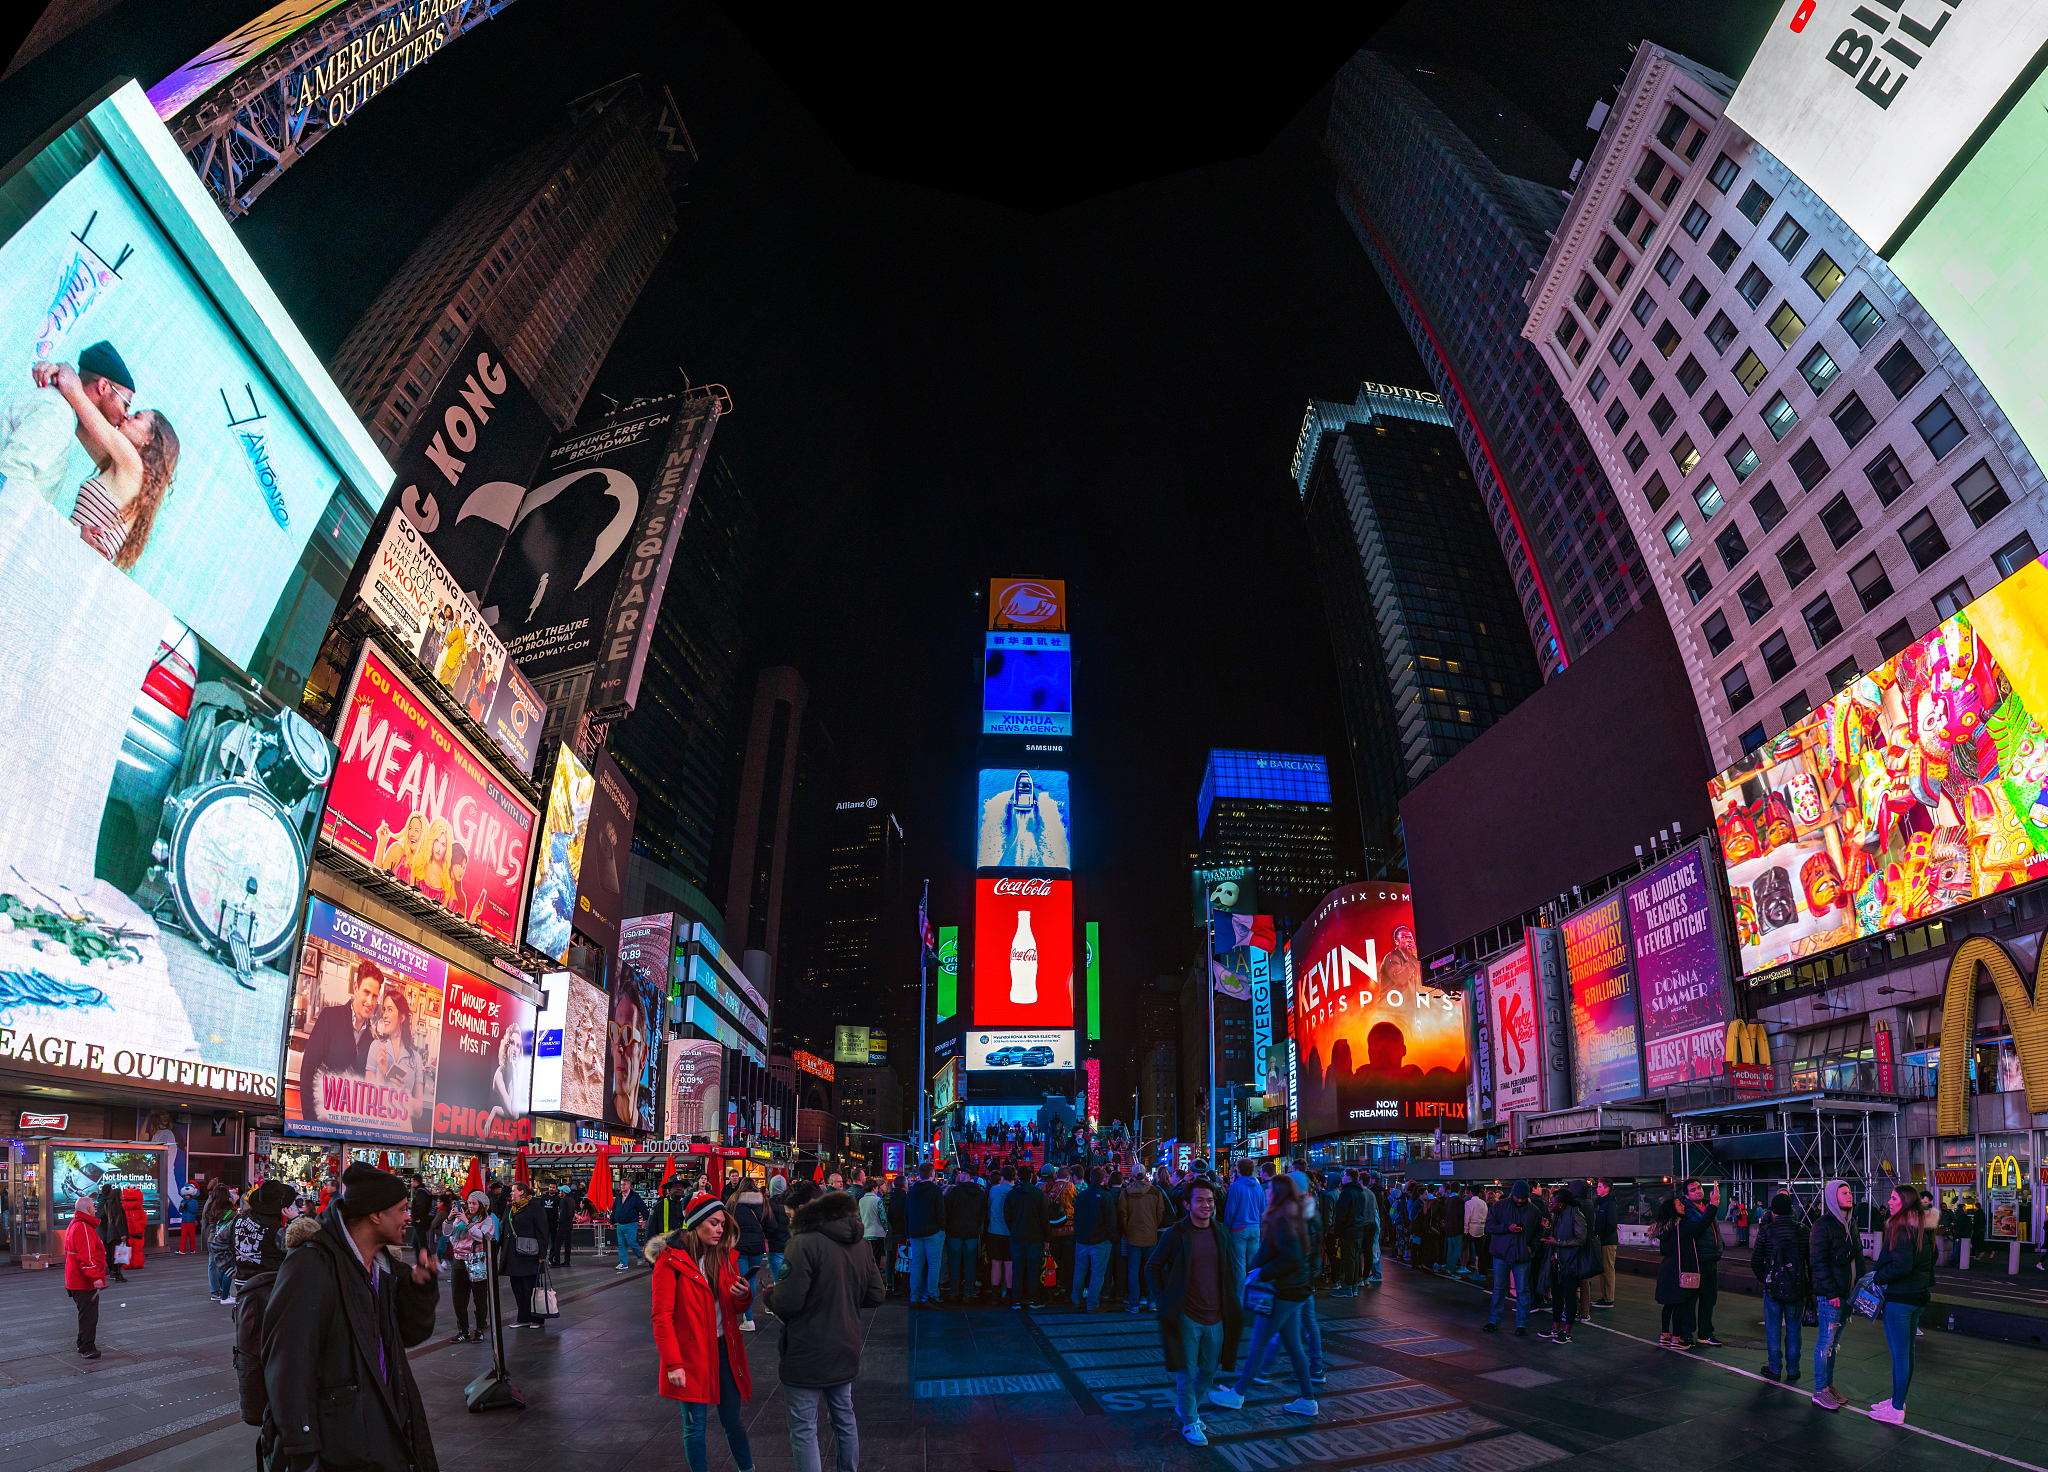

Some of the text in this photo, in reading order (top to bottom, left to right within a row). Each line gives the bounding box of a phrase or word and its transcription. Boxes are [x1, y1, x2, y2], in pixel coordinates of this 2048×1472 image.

[297, 6, 415, 114] AMERICAN
[329, 22, 445, 127] OUTFITTERS
[425, 352, 506, 487] KONG
[550, 415, 670, 459] BREAKING FREE ON
[570, 433, 640, 461] BROADWAY
[608, 417, 704, 662] TIMES SQUARE
[388, 541, 410, 568] THAT
[409, 566, 435, 603] GOES
[397, 536, 412, 558] THE
[413, 554, 436, 586] PLAY
[383, 550, 430, 617] WRONG
[398, 518, 505, 660] SO WRONG IT'S RIGHT
[545, 617, 590, 638] THEATRE
[525, 632, 576, 652] BROADWAY
[994, 636, 1062, 647] 新华通讯社
[601, 678, 621, 690] NYC
[508, 676, 539, 722] Avenue
[511, 700, 529, 739] Q
[990, 724, 1065, 733] NEWS AGENCY
[1002, 715, 1053, 726] XINHUA
[363, 661, 529, 831] YOU KNOW YOU WANNA SIT WITH US
[1025, 744, 1063, 752] SAMSUNG
[1270, 759, 1321, 771] BARCLAYS
[343, 704, 524, 886] MEAN GIRLS
[836, 801, 865, 811] Allianz
[994, 877, 1054, 897] Coca-Cola
[1202, 869, 1245, 880] PHANTOM
[1651, 862, 1698, 905] AUDIENCE
[1314, 919, 1318, 928] A
[1319, 892, 1367, 921] NETFLIX
[1577, 900, 1620, 939] INSPIRED
[1646, 893, 1688, 930] REACHES
[333, 917, 429, 972] JOEY McINTYRE
[351, 941, 377, 958] THROUGH
[377, 953, 392, 966] APRIL
[621, 949, 641, 961] 0.89
[1566, 921, 1622, 969] BROADWAY
[1637, 938, 1644, 958] A
[1643, 925, 1673, 955] FEVER
[1298, 938, 1378, 1018] KEVIN
[1506, 961, 1517, 975] MISS
[1517, 954, 1528, 968] THIS
[1655, 969, 1699, 996] DONNA
[450, 983, 502, 1018] IT WOULD BE
[1540, 937, 1564, 1071] PALACE
[1651, 982, 1708, 1012] SUMMER
[448, 1007, 500, 1038] CRIMINAL TO
[460, 1033, 491, 1056] MISS IT
[1474, 974, 1492, 1112] JUST CAUSE 4
[1589, 1025, 1636, 1052] SPONGEBOB
[1648, 1029, 1726, 1072] JERSEY BOYS
[0, 1028, 277, 1098] EAGLE OUTFITTERS
[1590, 1042, 1637, 1065] SQUAREPANTS
[1510, 1074, 1538, 1088] PERFORMANCE
[322, 1074, 409, 1121] WAITRESS
[1376, 1100, 1398, 1109] NOW
[1415, 1101, 1465, 1119] NETFLIX
[351, 1116, 379, 1126] BROADWAY
[380, 1119, 402, 1128] MUSICAL
[433, 1102, 532, 1142] CHICAGO
[1349, 1109, 1399, 1119] STREAMING
[292, 1123, 311, 1131] BROOKS
[311, 1125, 334, 1134] ATKINSON
[334, 1128, 353, 1136] THEATRE
[582, 1128, 597, 1139] BLUE
[599, 1130, 609, 1141] FIN
[360, 1150, 405, 1166] GRND
[528, 1137, 598, 1154] nuchas
[621, 1141, 634, 1153] NY
[642, 1140, 690, 1153] HOTDOGS
[888, 1145, 901, 1171] tkts
[1178, 1146, 1192, 1173] tkts
[128, 1173, 144, 1181] time
[919, 1373, 1061, 1398] HIRSCHFELD
[1214, 1410, 1468, 1472] AMSTERDAM
